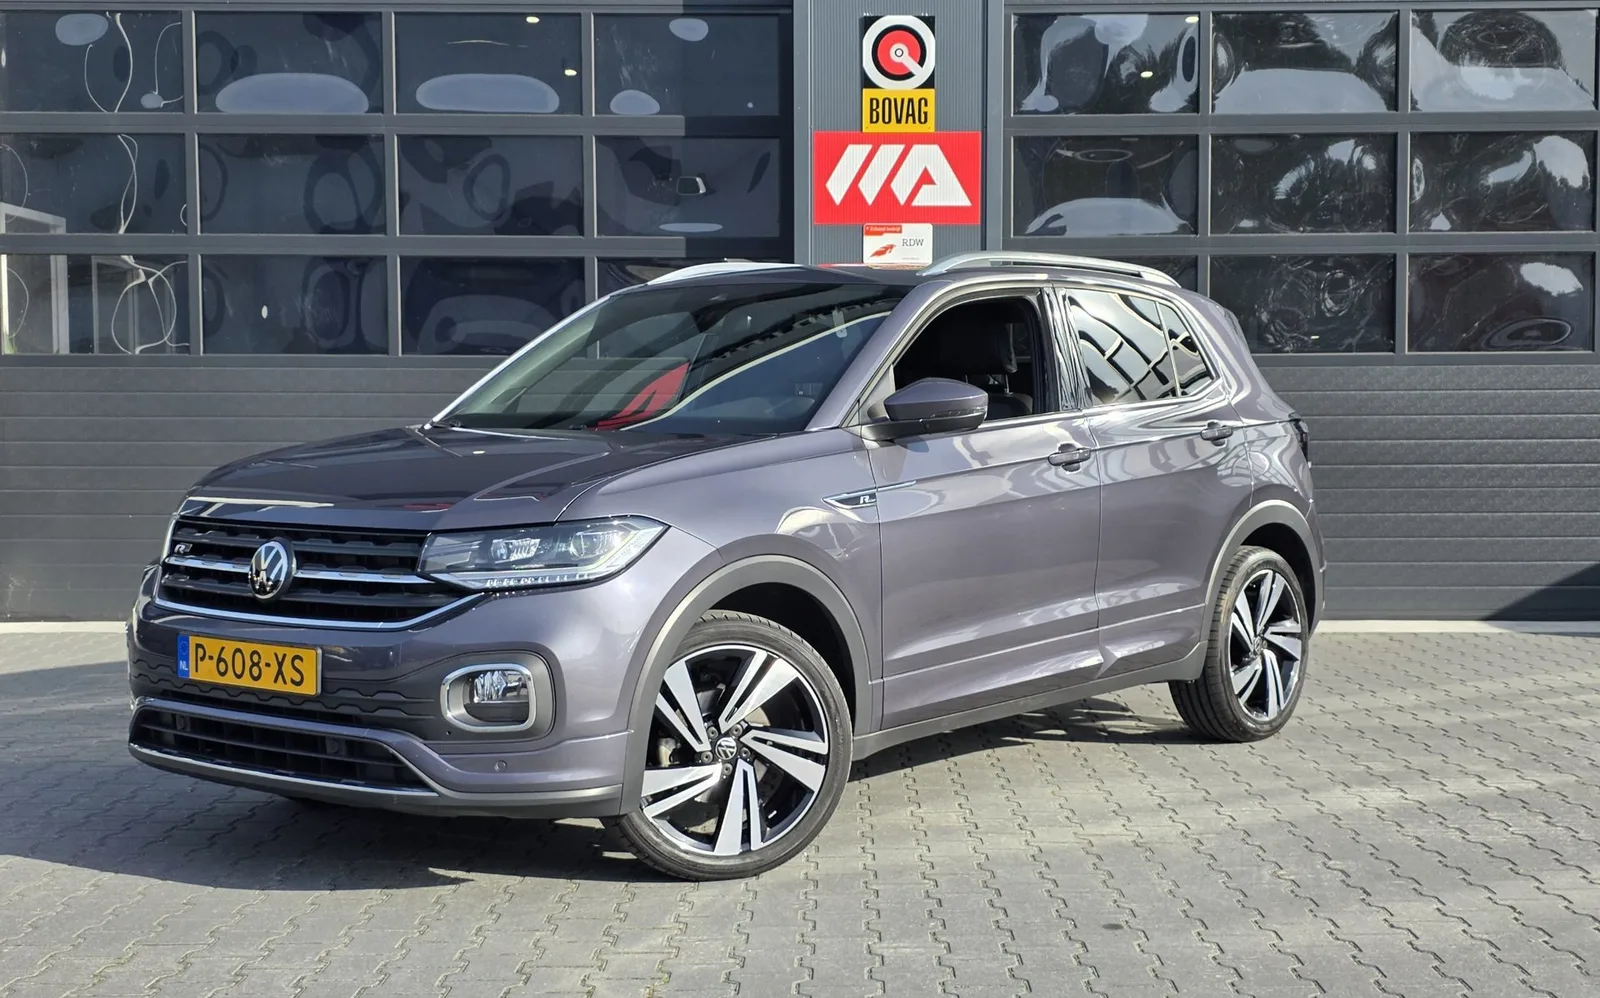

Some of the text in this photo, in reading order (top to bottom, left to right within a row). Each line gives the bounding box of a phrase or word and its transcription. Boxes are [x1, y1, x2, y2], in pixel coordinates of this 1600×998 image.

[869, 97, 928, 125] BOVAG
[902, 238, 924, 247] RDW
[179, 660, 189, 671] NL
[194, 643, 305, 687] P-608-XS
